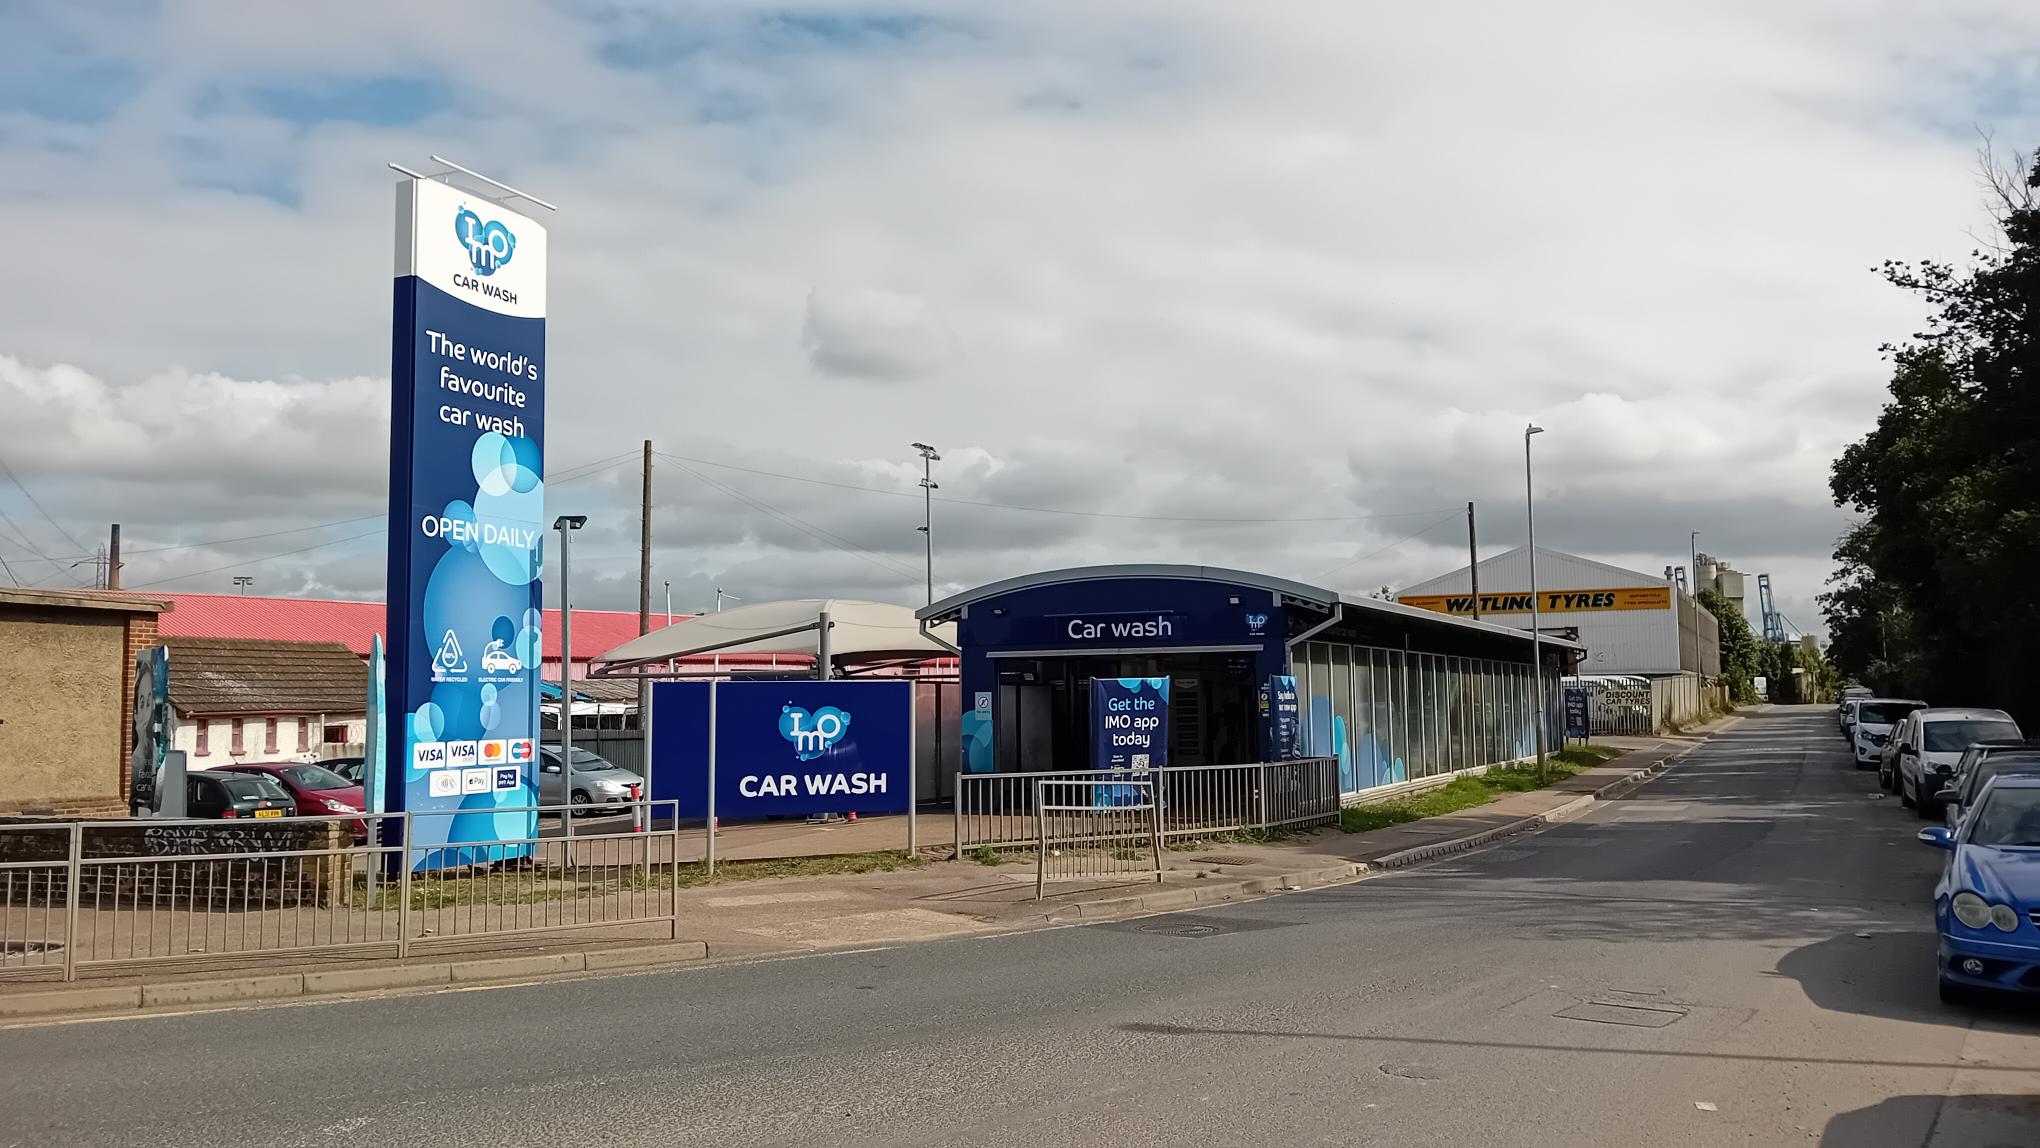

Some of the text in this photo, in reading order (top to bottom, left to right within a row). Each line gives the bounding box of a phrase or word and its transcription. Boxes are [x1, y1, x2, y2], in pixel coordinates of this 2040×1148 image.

[453, 273, 518, 305] CAR WASH
[425, 330, 538, 381] The world's
[440, 366, 526, 408] favourite
[439, 405, 525, 439] car wash
[422, 515, 535, 549] OPEN DAILY
[1548, 592, 1616, 609] TYRES
[1067, 615, 1172, 639] Car wash
[1108, 696, 1155, 711] Get the
[1605, 691, 1650, 699] DISCOUNT
[1105, 714, 1159, 731] IMO app
[1112, 731, 1151, 748] today
[418, 749, 443, 762] VISA
[451, 744, 475, 757] VISA
[474, 777, 485, 786] Pay
[739, 772, 887, 798] CAR WASH
